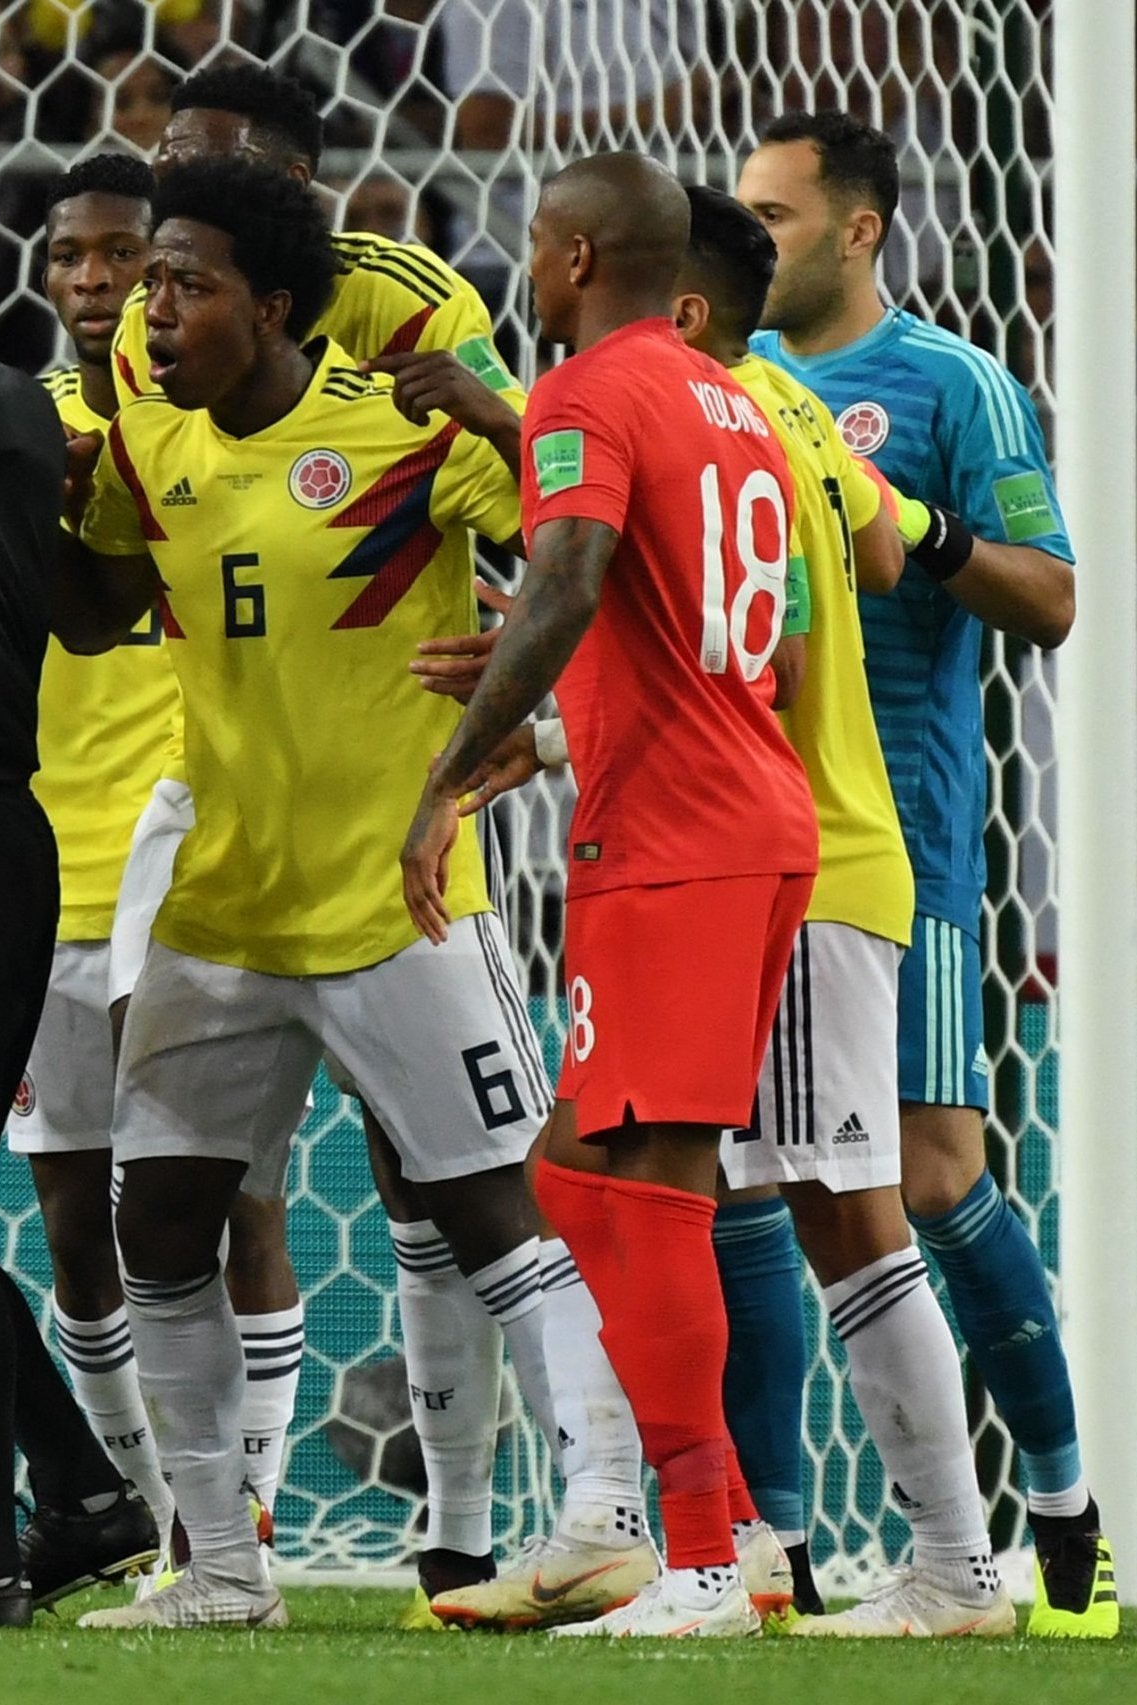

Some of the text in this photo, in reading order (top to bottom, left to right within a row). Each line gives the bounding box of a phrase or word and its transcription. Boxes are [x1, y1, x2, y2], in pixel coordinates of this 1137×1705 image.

[687, 380, 770, 438] YOUNG
[161, 496, 197, 506] adidas
[699, 463, 788, 682] 18
[221, 553, 266, 638] 6
[462, 1040, 527, 1130] 6
[832, 1132, 870, 1144] adidas
[410, 1384, 455, 1411] FCF
[103, 1427, 147, 1450] FCF
